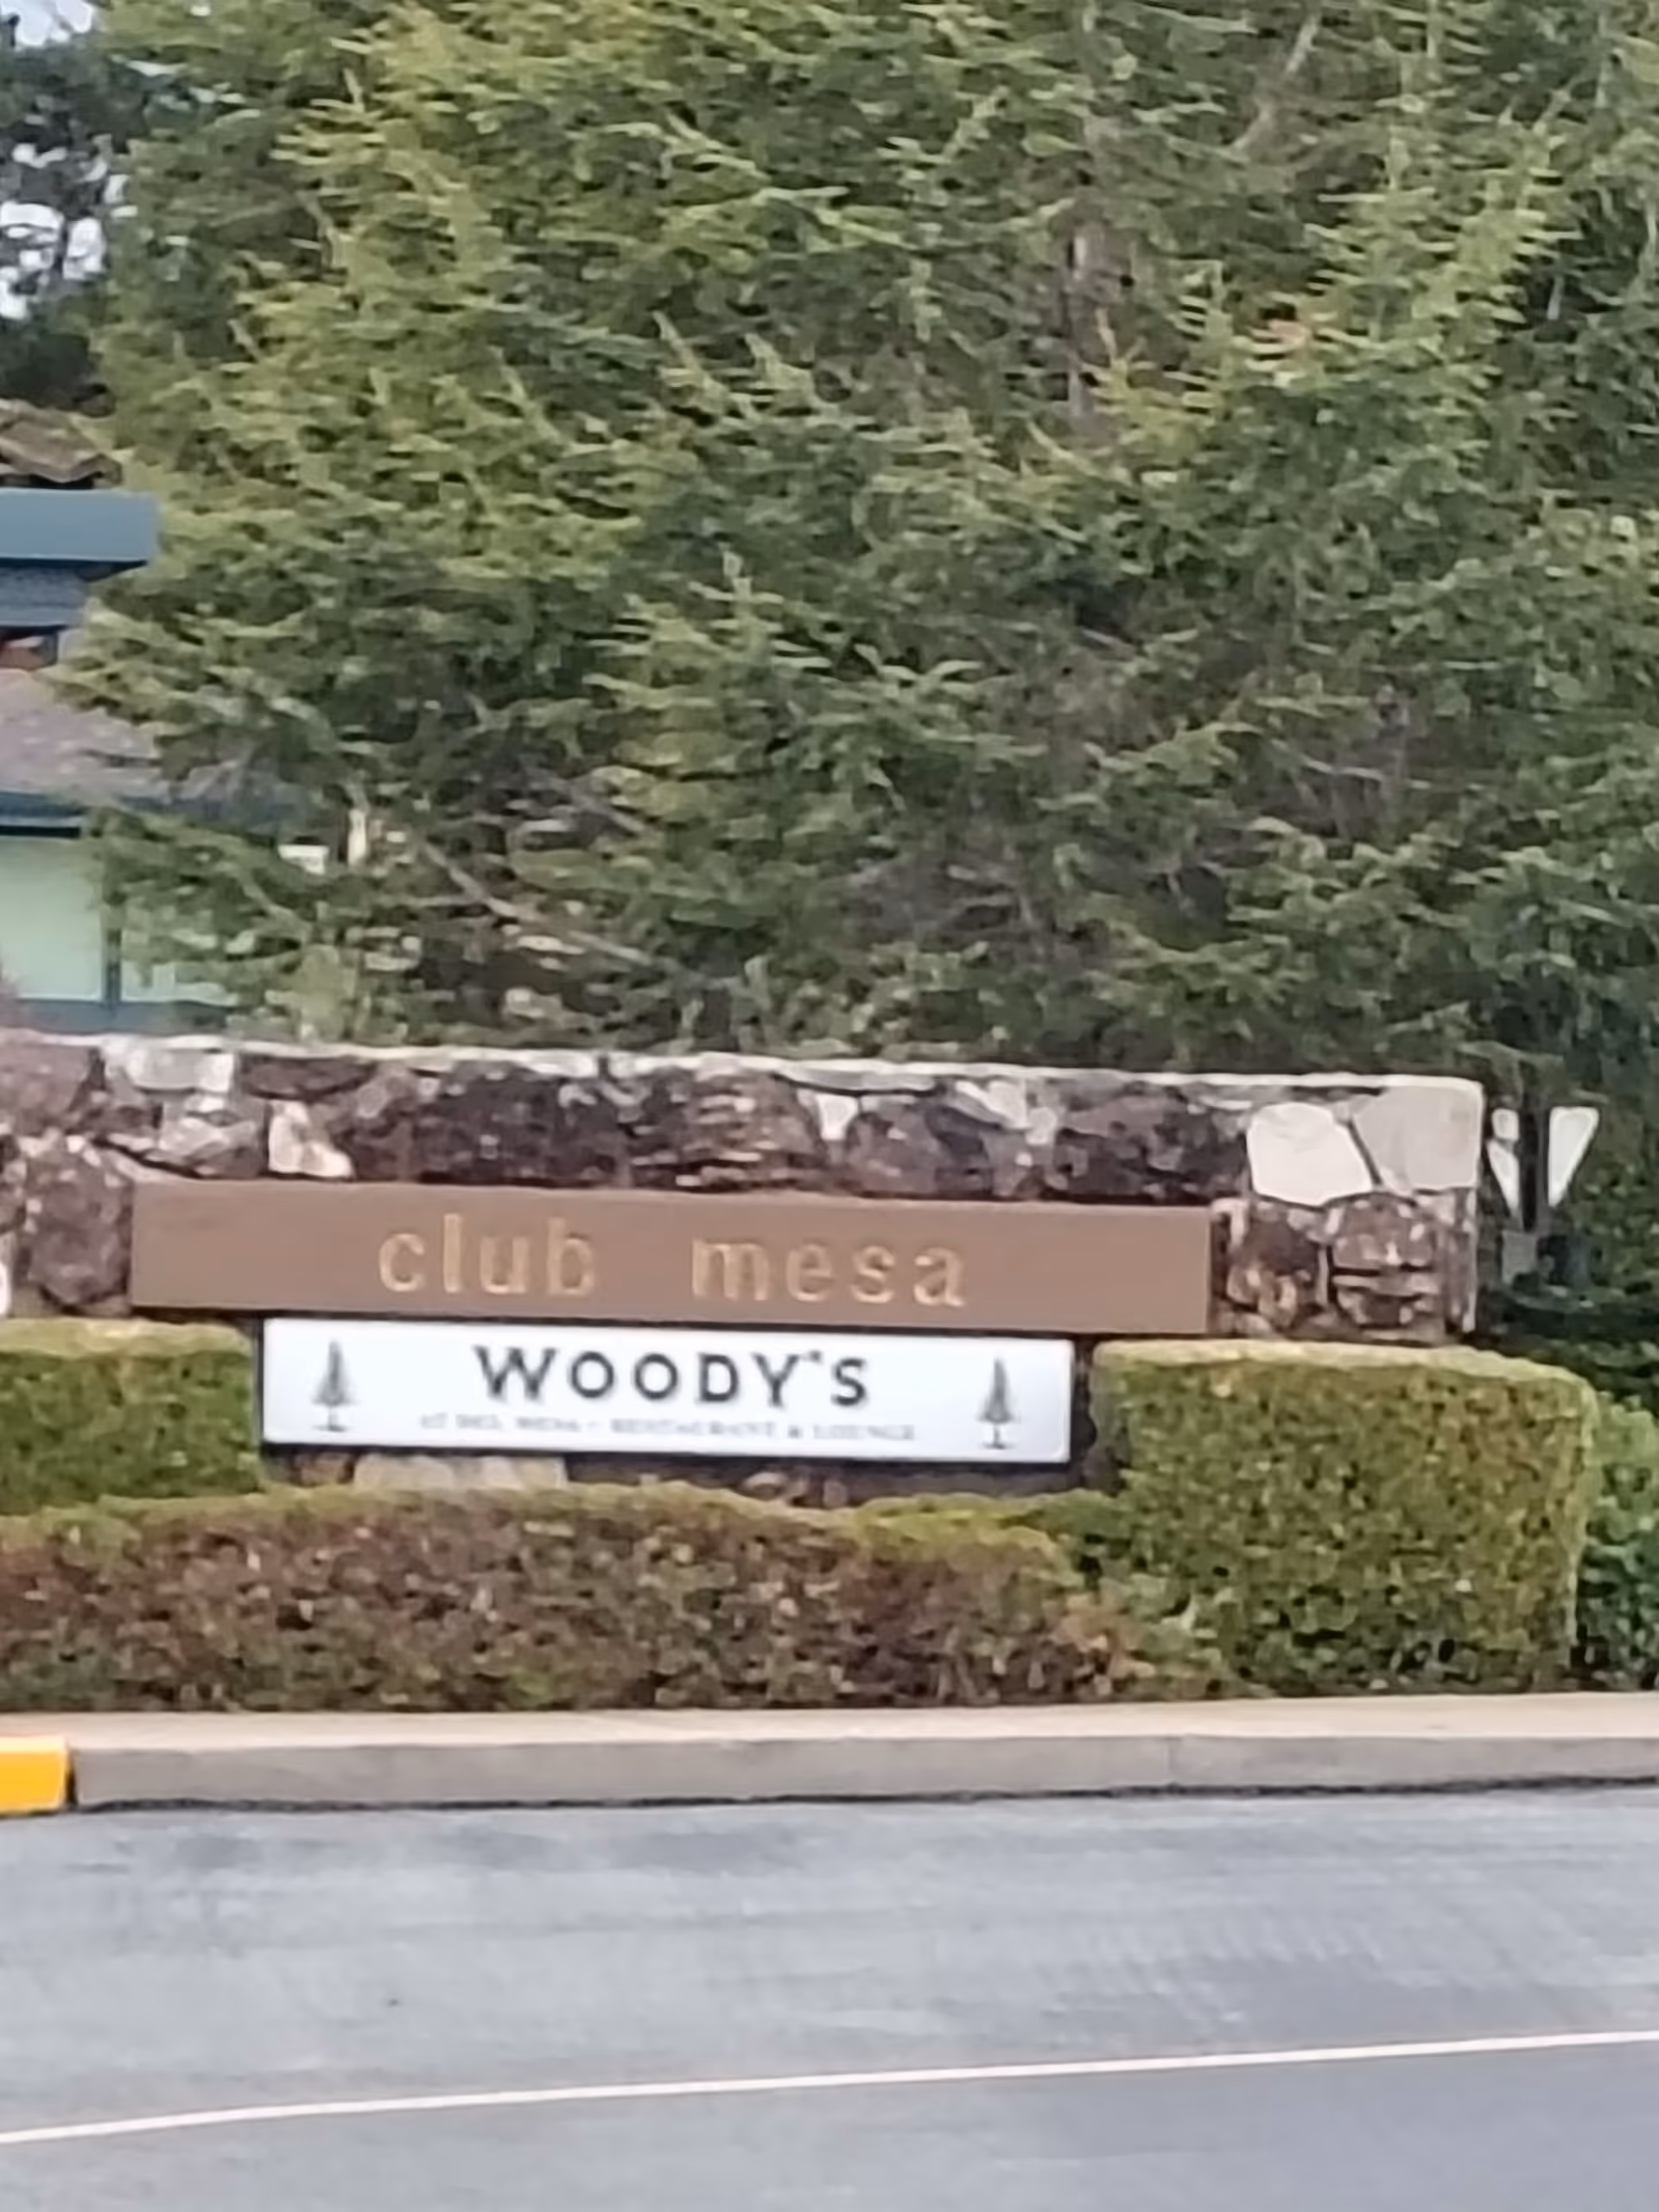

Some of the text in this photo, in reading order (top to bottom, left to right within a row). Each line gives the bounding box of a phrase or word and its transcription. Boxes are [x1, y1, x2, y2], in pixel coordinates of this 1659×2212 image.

[378, 1212, 965, 1307] club mesa
[473, 1344, 868, 1408] WOODY'S
